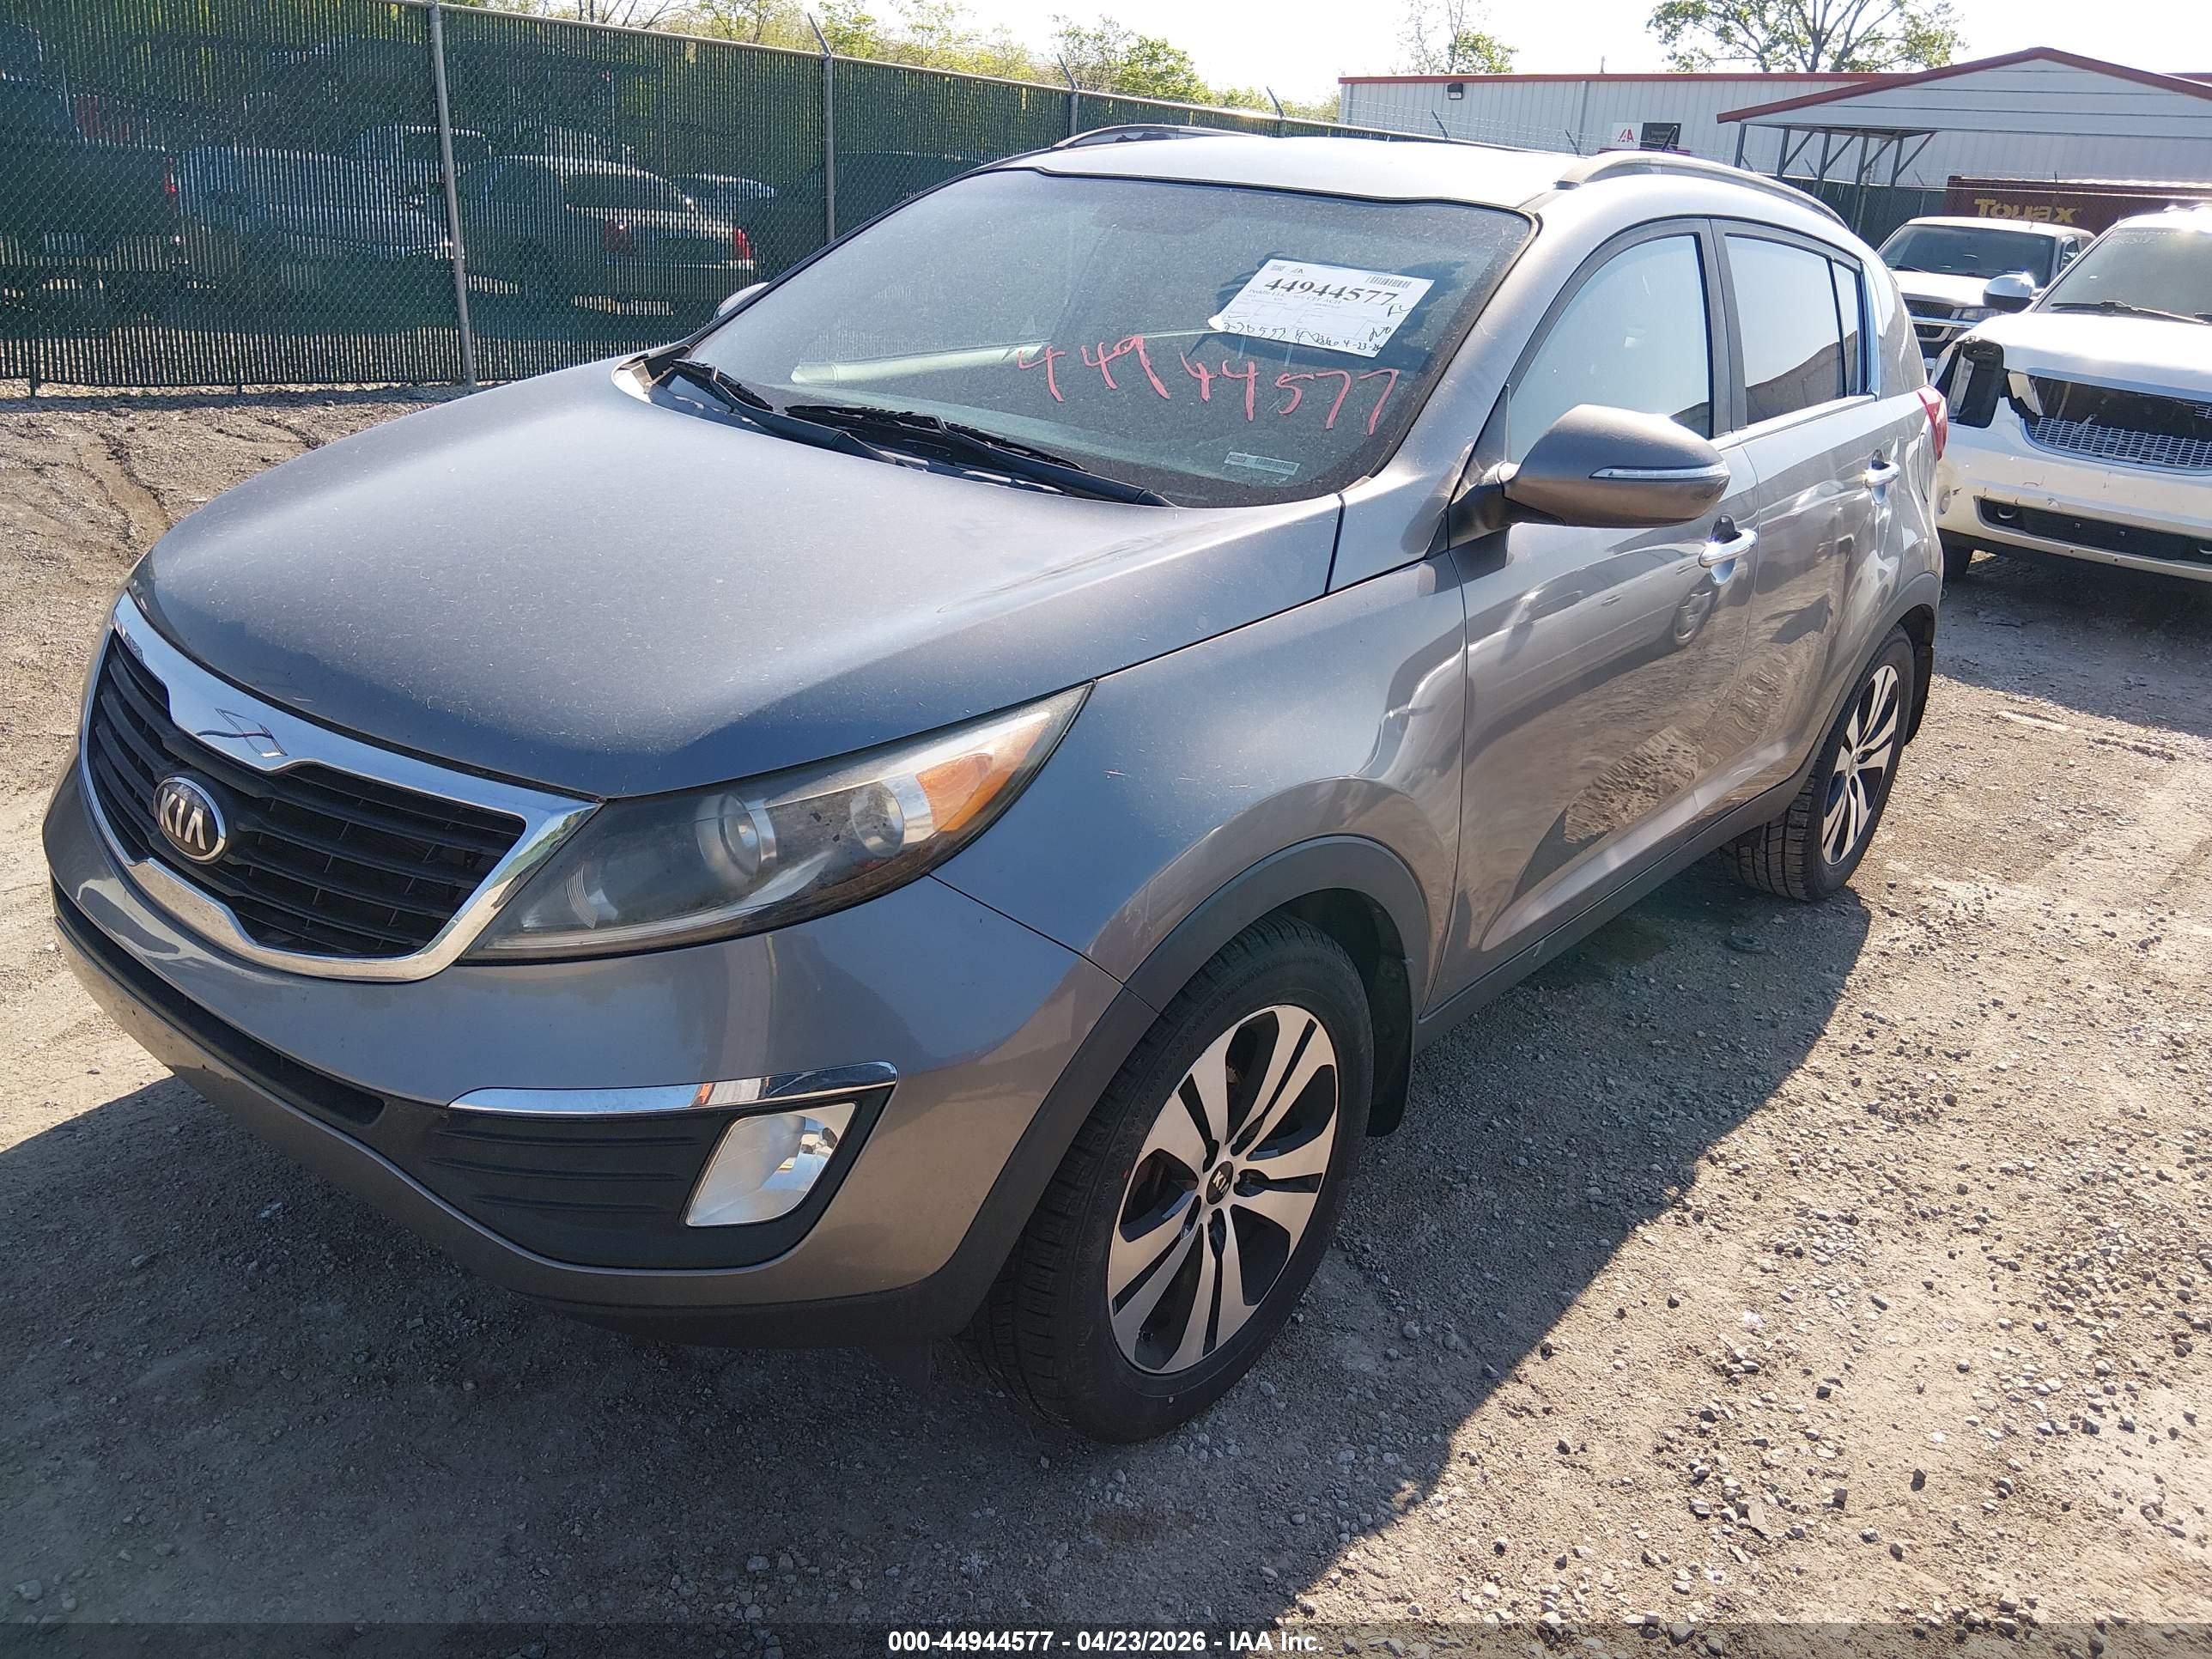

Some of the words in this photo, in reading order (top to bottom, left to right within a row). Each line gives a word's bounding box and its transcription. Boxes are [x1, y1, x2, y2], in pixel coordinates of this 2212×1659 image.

[1264, 278, 1399, 306] 44944577
[1018, 335, 1401, 436] 44944577
[159, 787, 207, 851] KIA
[1212, 1170, 1229, 1196] KIA
